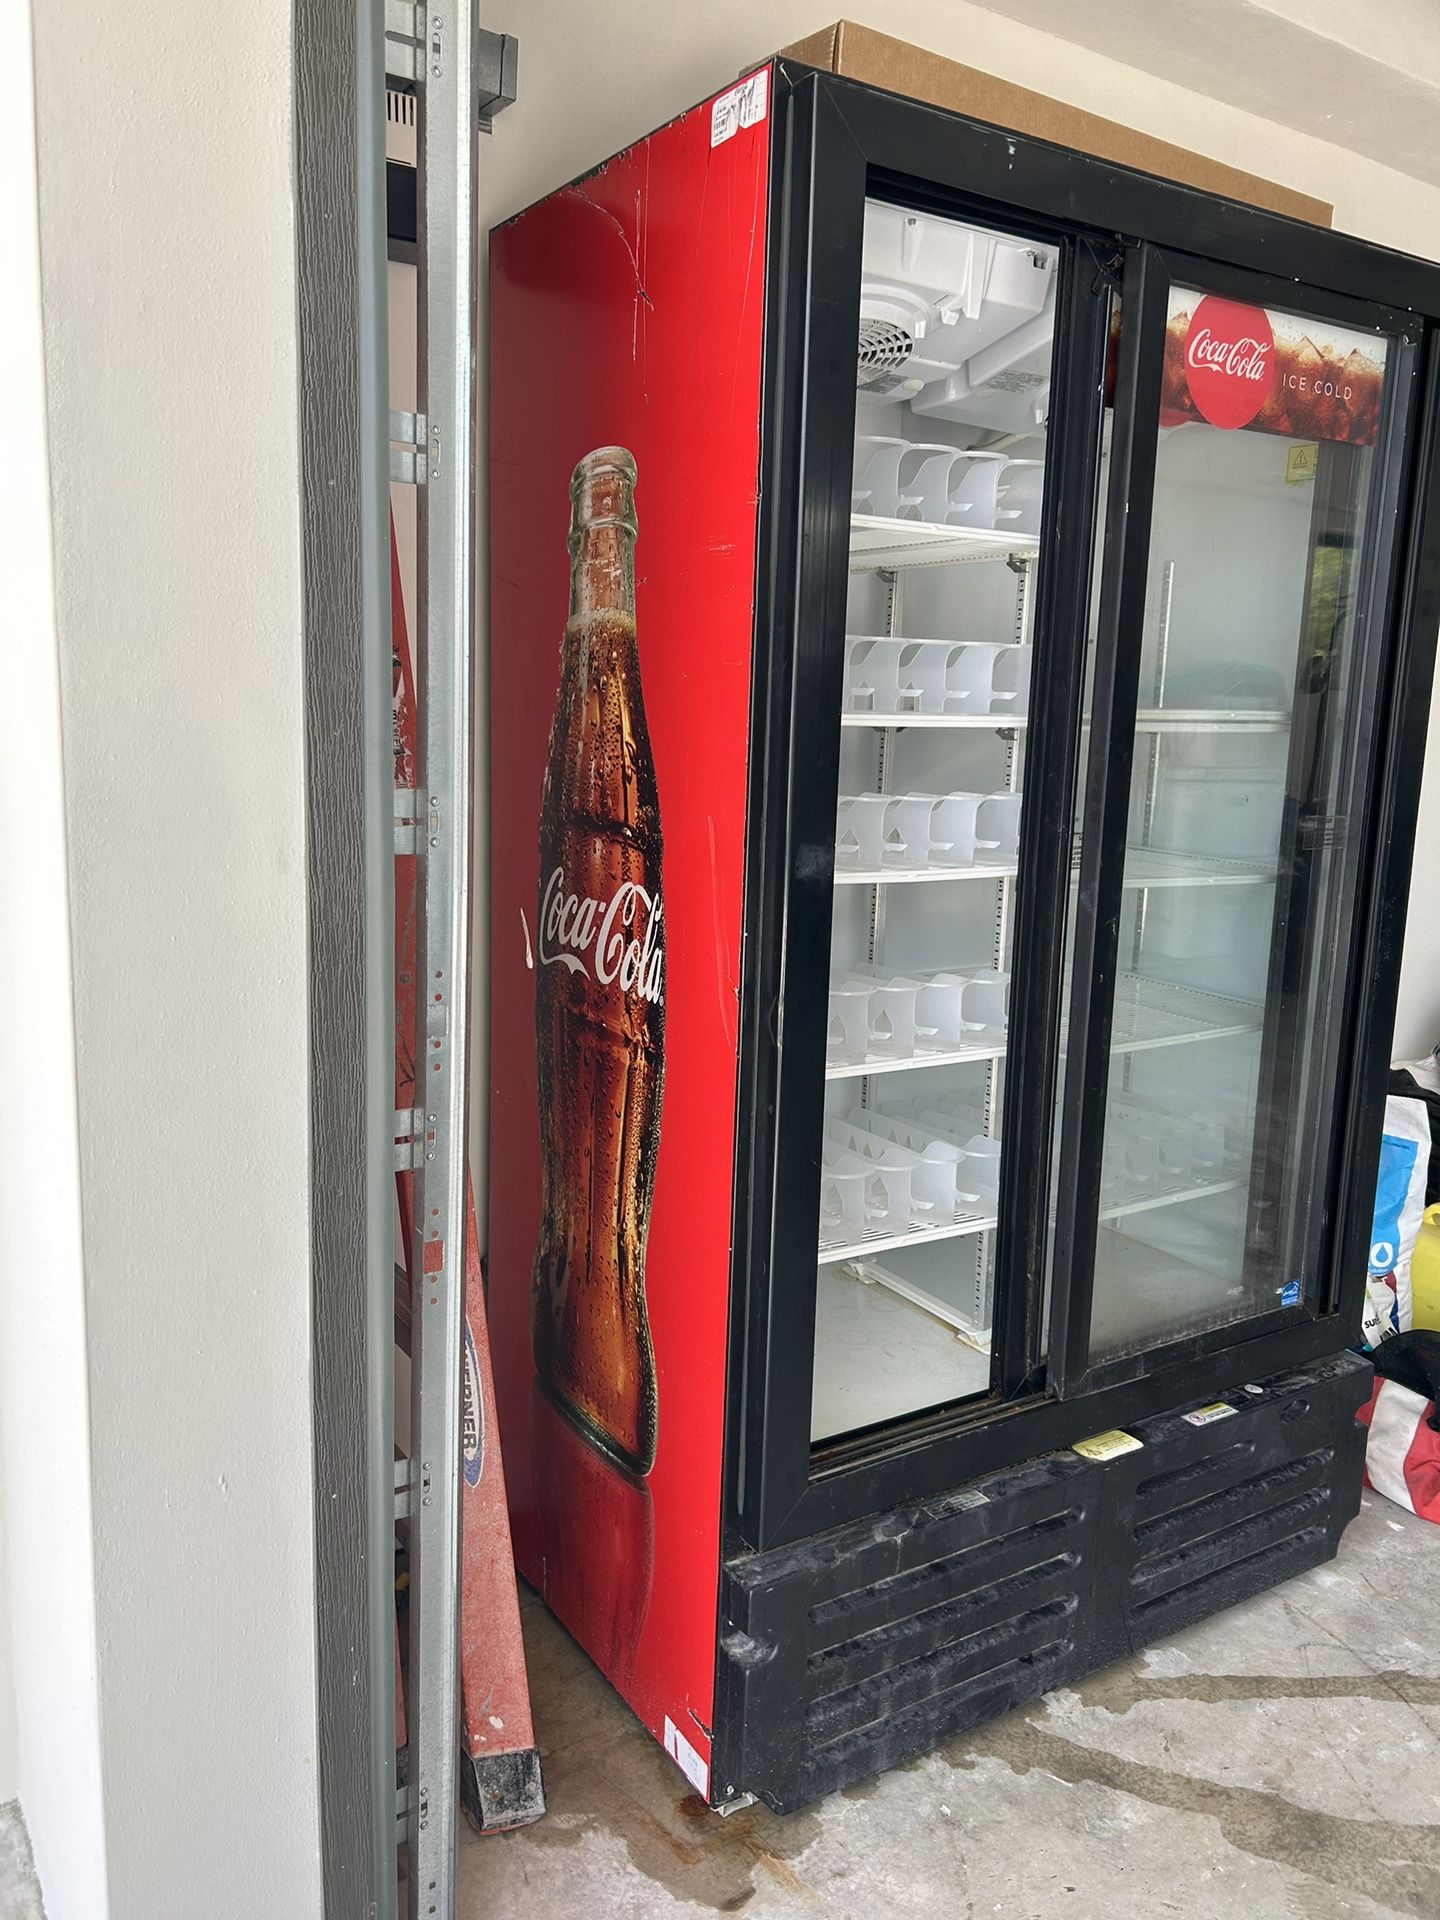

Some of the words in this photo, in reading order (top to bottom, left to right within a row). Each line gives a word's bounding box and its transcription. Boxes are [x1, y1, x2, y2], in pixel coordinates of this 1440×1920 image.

[1188, 328, 1271, 381] Coca-Cola
[1282, 373, 1306, 391] ICE
[1315, 380, 1352, 400] COLD
[539, 866, 664, 1004] Coca-Cola
